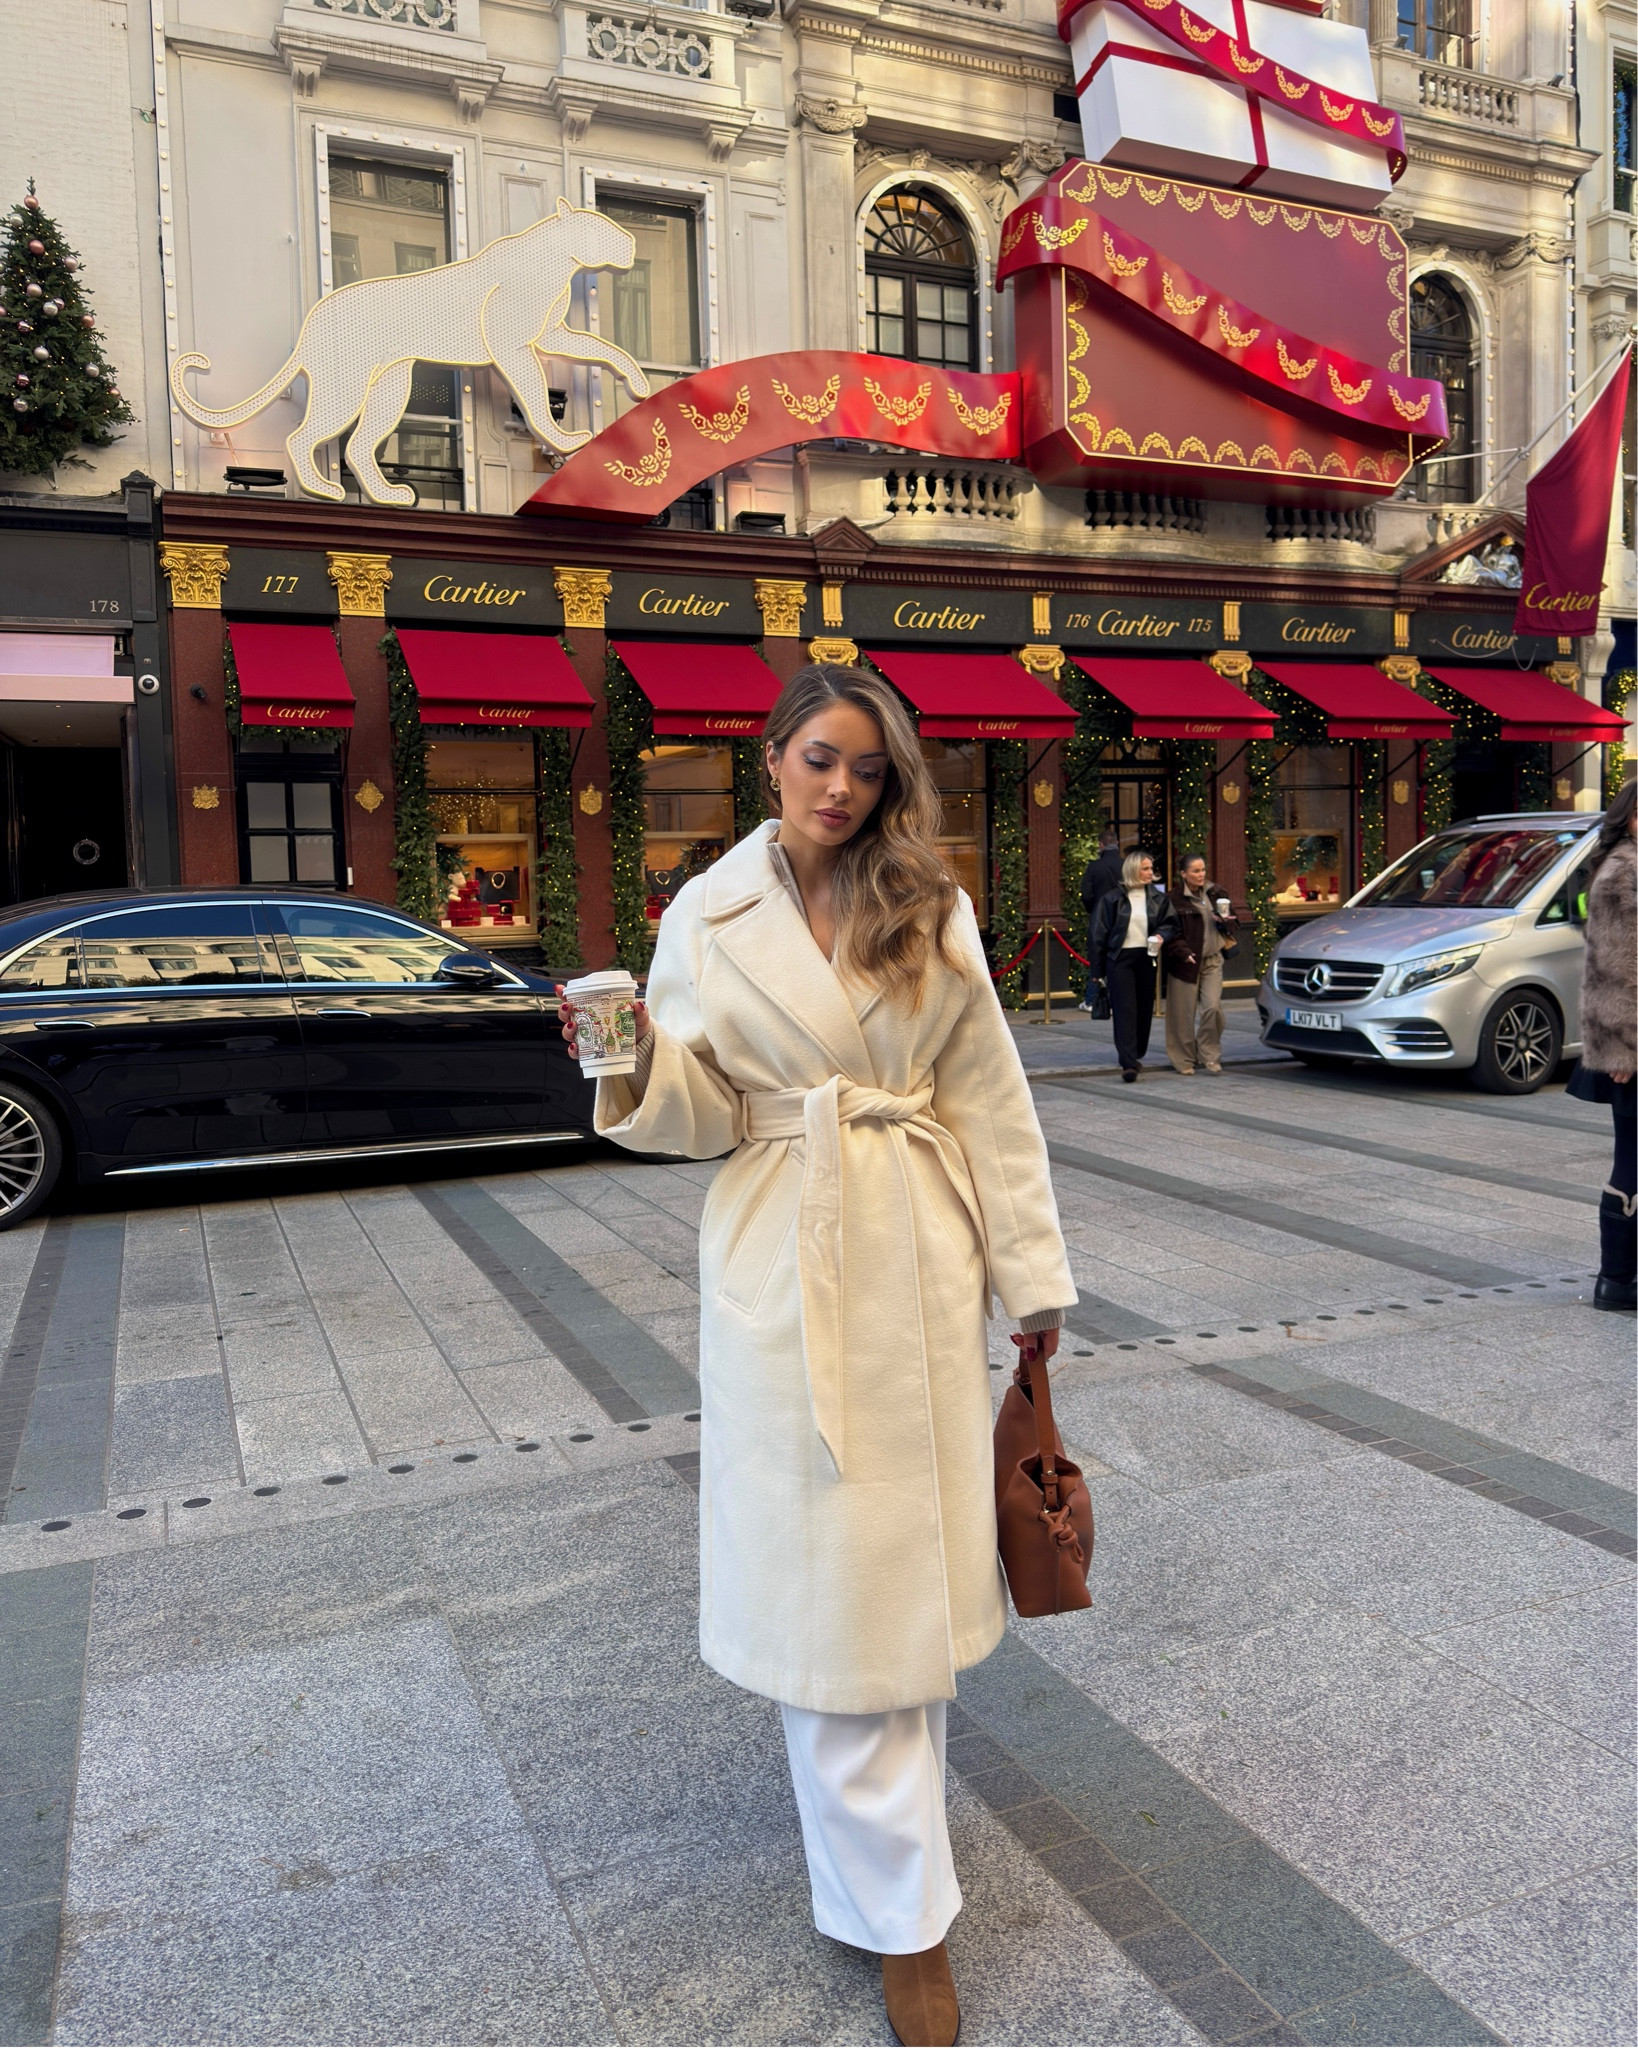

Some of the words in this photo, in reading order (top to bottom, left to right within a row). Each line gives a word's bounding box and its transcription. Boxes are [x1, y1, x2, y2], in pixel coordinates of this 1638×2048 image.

[261, 576, 299, 593] 177
[423, 575, 526, 606] Cartier
[639, 589, 730, 616] Cartier
[1525, 582, 1598, 612] Cartier
[90, 600, 119, 613] 178
[893, 601, 985, 630] Cartier
[1065, 614, 1091, 628] 176
[1097, 609, 1179, 637] Cartier
[1187, 618, 1212, 632] 175
[1282, 617, 1355, 643] Cartier
[1452, 624, 1517, 650] Cartier
[267, 703, 329, 719] Cartier
[478, 703, 534, 719] Cartier
[705, 716, 755, 729] Cartier
[978, 718, 1020, 731] Cartier
[1184, 722, 1223, 735] Cartier
[1292, 1013, 1313, 1027] LK17
[1315, 1014, 1337, 1028] VLT
